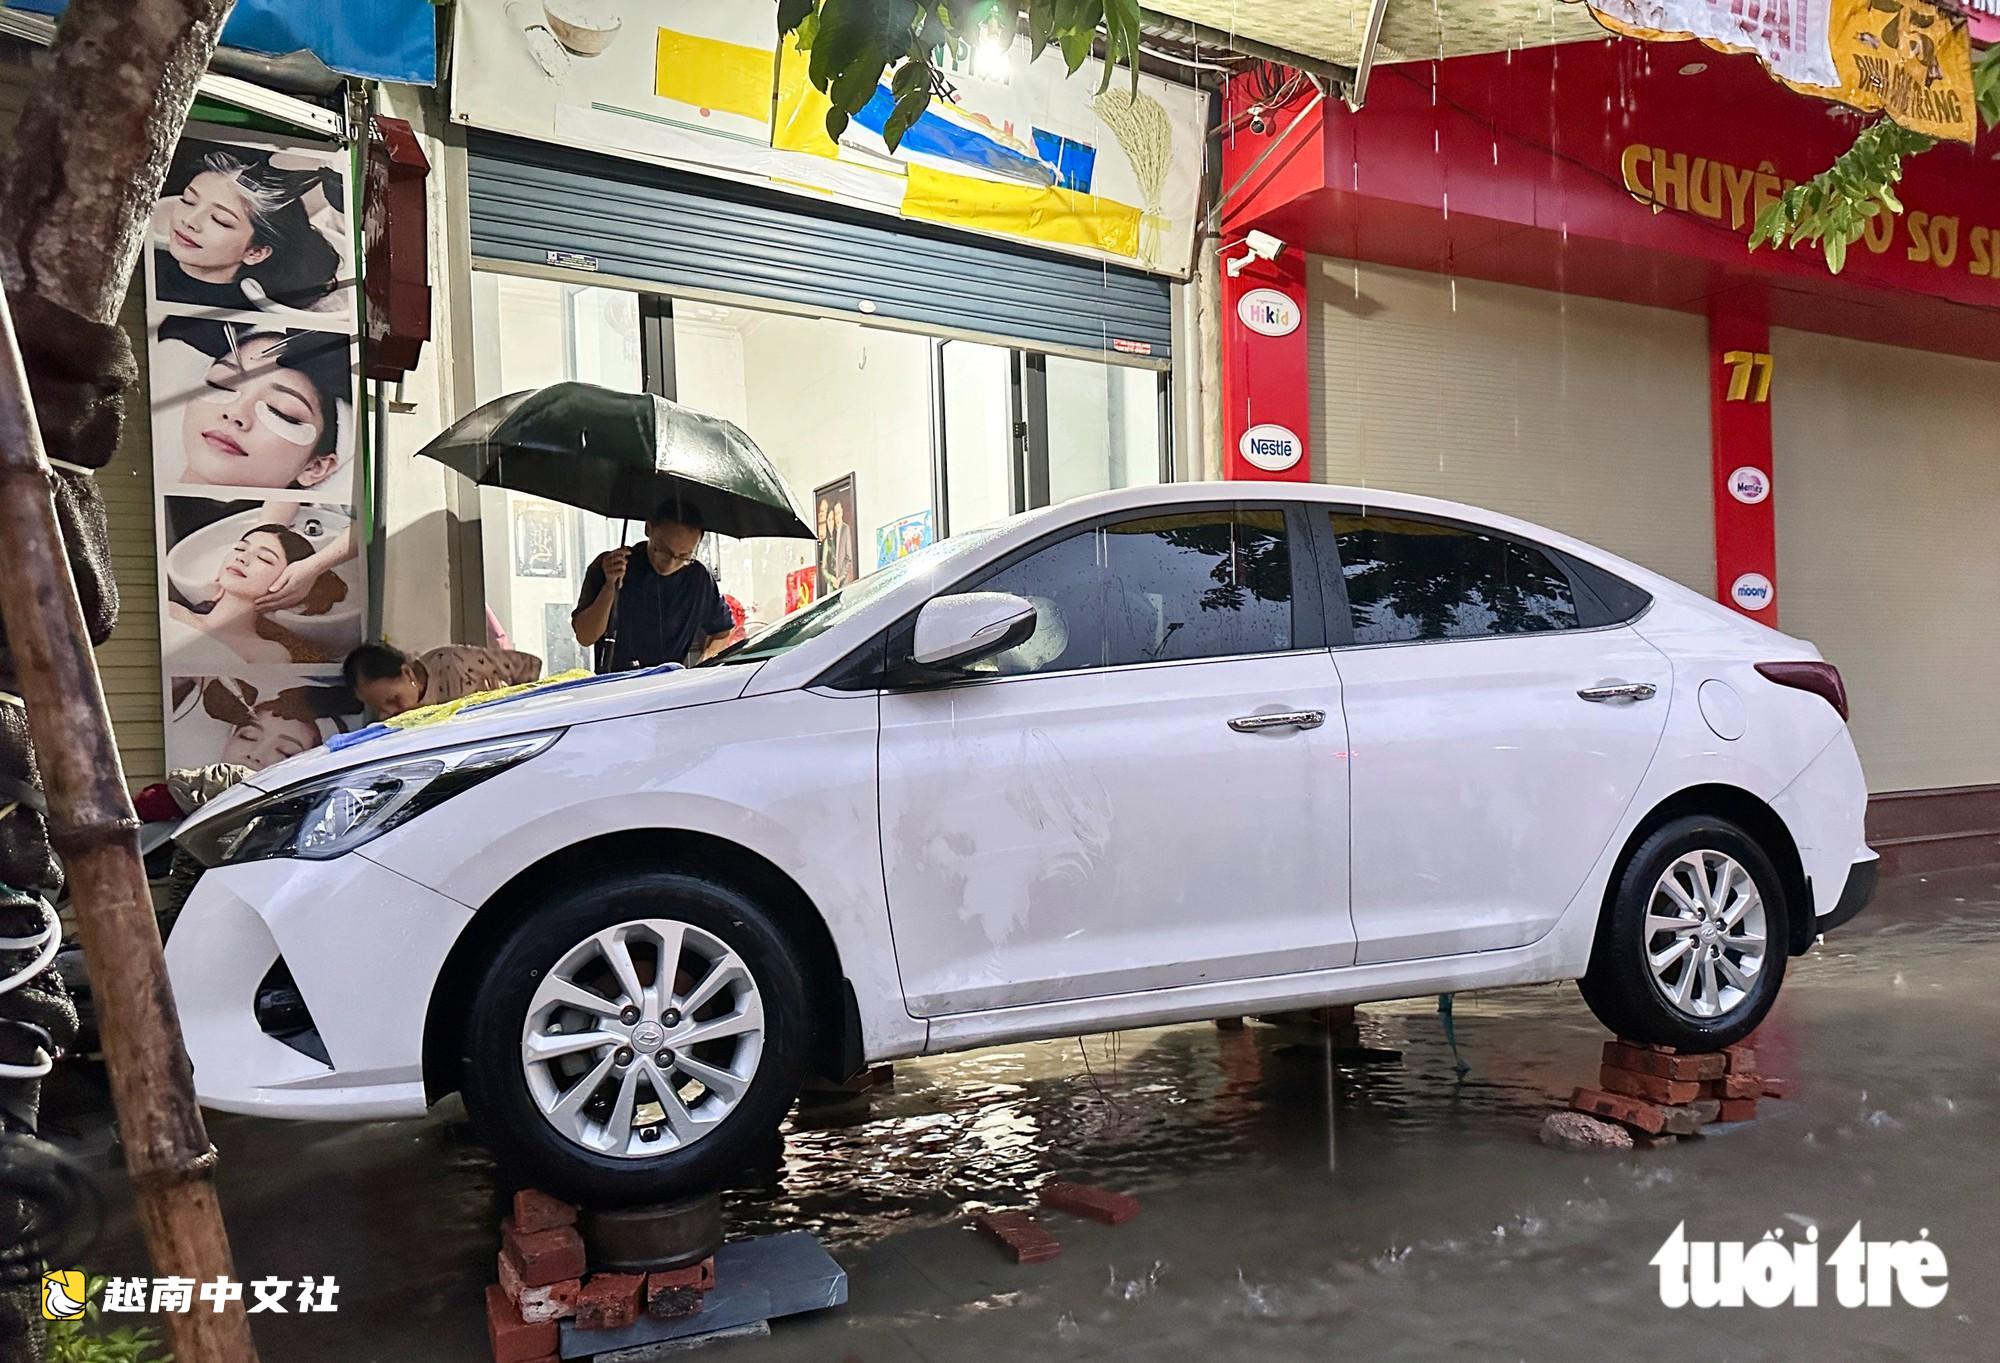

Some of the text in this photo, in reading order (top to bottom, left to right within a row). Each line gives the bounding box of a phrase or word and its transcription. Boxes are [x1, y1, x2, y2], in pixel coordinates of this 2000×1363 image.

[1621, 143, 1816, 240] CHUYÊ
[1250, 304, 1289, 327] Hikid
[1723, 350, 1774, 402] 77
[1737, 586, 1767, 599] moony
